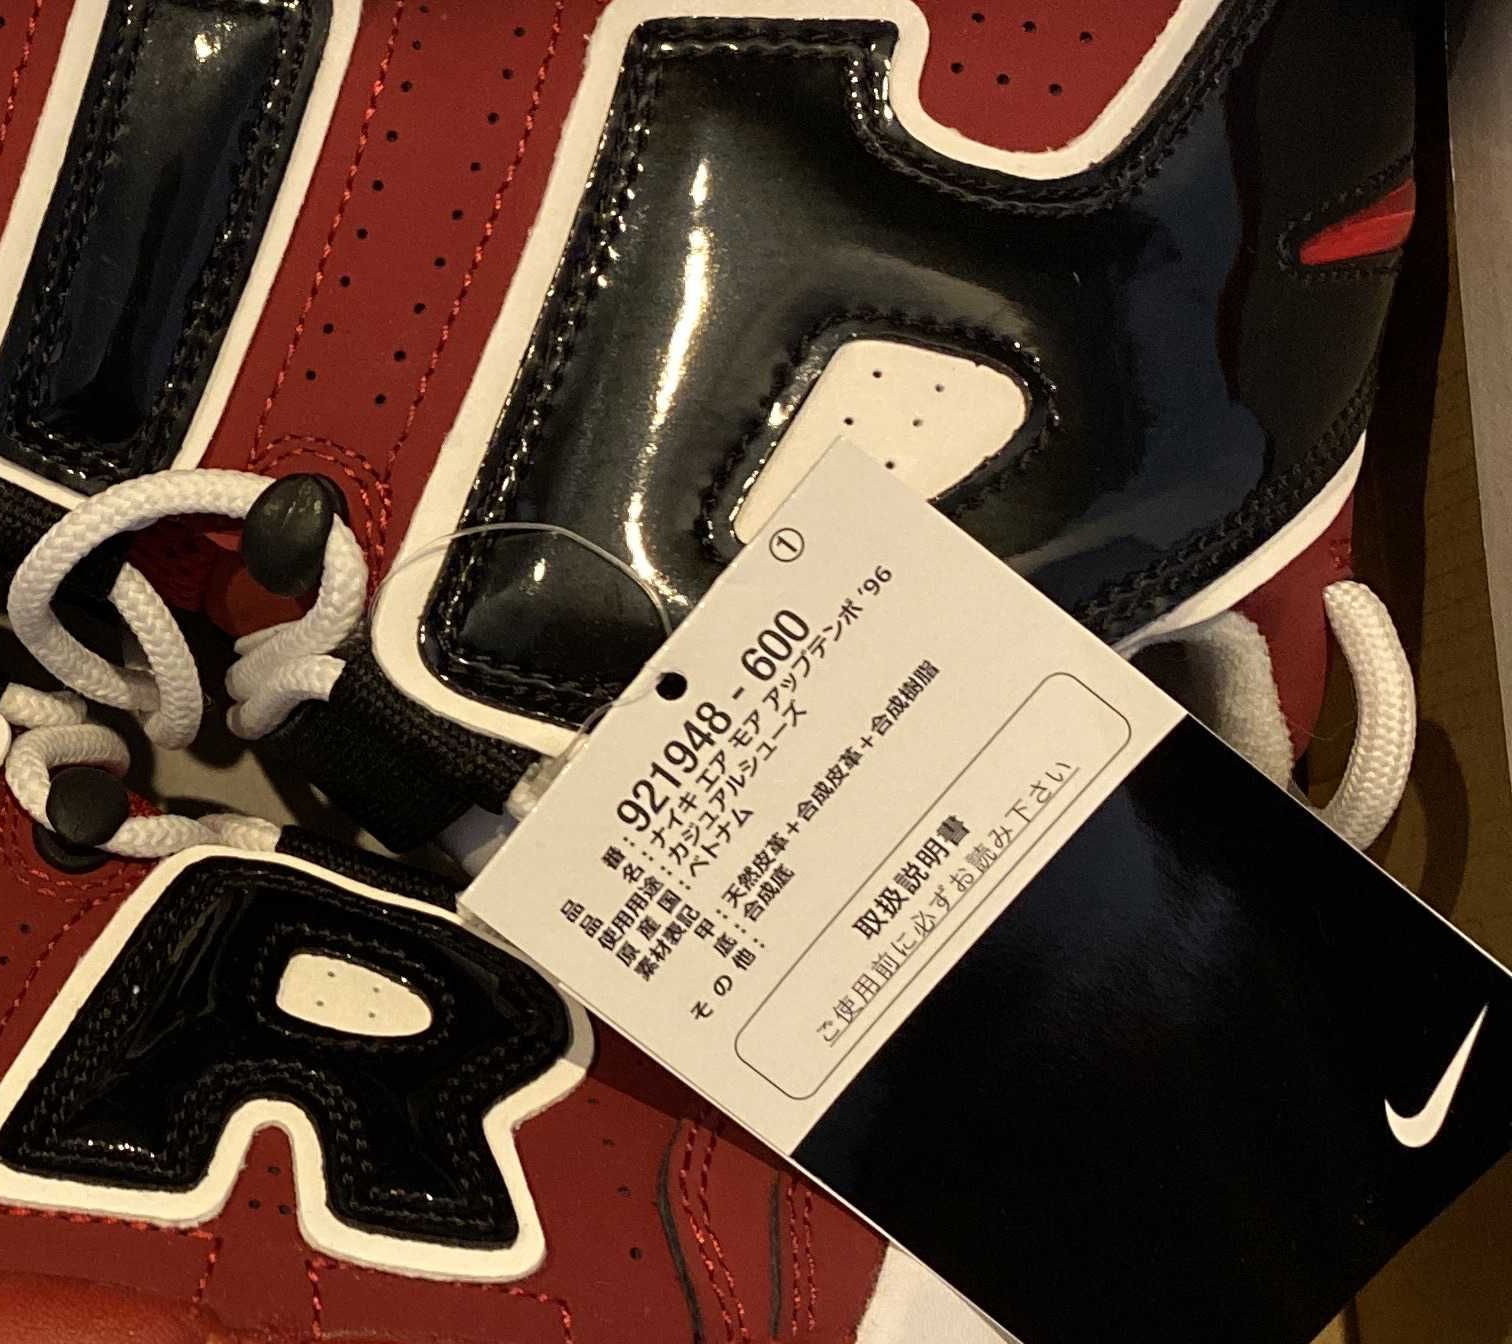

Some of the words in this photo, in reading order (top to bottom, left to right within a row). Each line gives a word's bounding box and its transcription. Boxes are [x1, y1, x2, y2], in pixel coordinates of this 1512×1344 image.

[616, 701, 732, 832] 921948
[740, 609, 810, 681] 600
[817, 761, 1076, 1042] ご使用前に必ずお読み下さい
[850, 814, 970, 940] 取扱説明書
